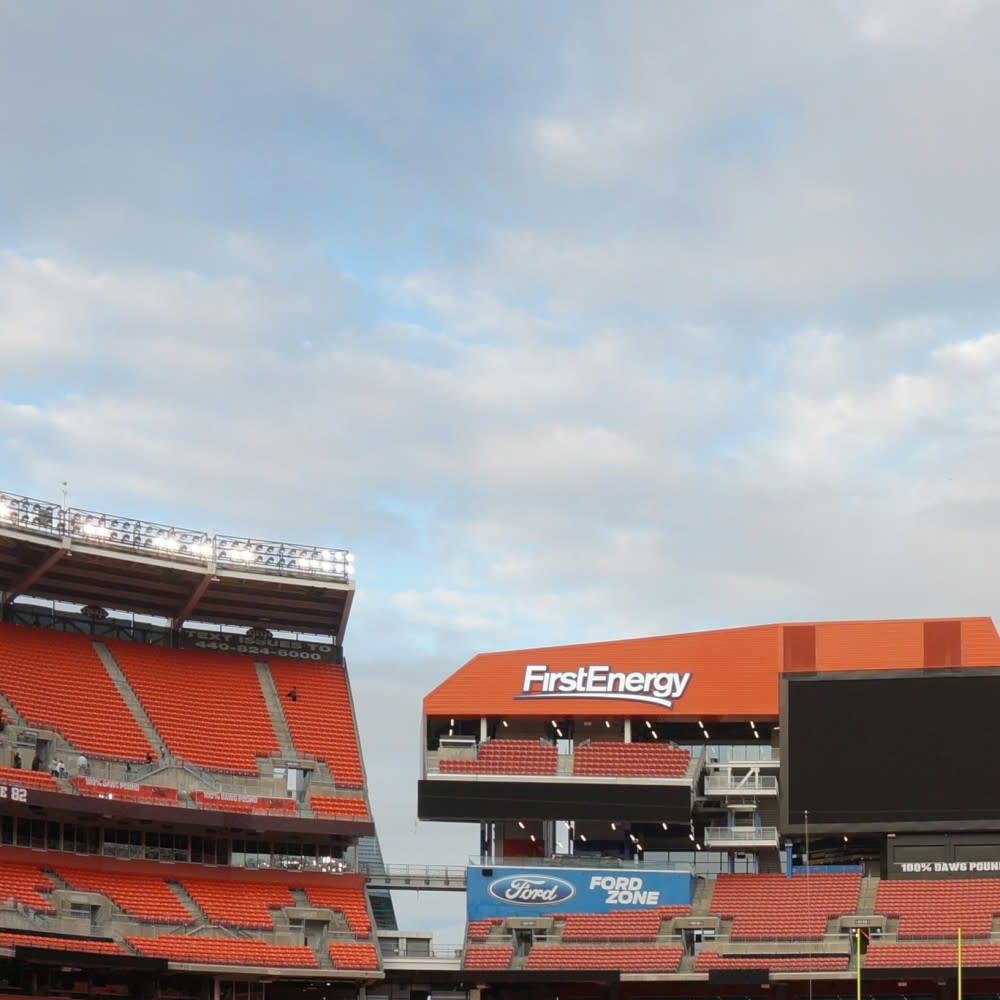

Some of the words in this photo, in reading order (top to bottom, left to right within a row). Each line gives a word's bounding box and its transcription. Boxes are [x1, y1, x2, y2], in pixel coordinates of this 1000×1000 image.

[186, 631, 233, 642] TEXT
[308, 643, 331, 653] TO
[522, 664, 692, 698] FirstEnergy
[11, 787, 27, 803] 82
[901, 862, 932, 873] 100%
[934, 862, 967, 872] DAWG
[505, 878, 559, 901] Ford
[589, 876, 643, 890] FORD
[605, 890, 660, 905] ZONE
